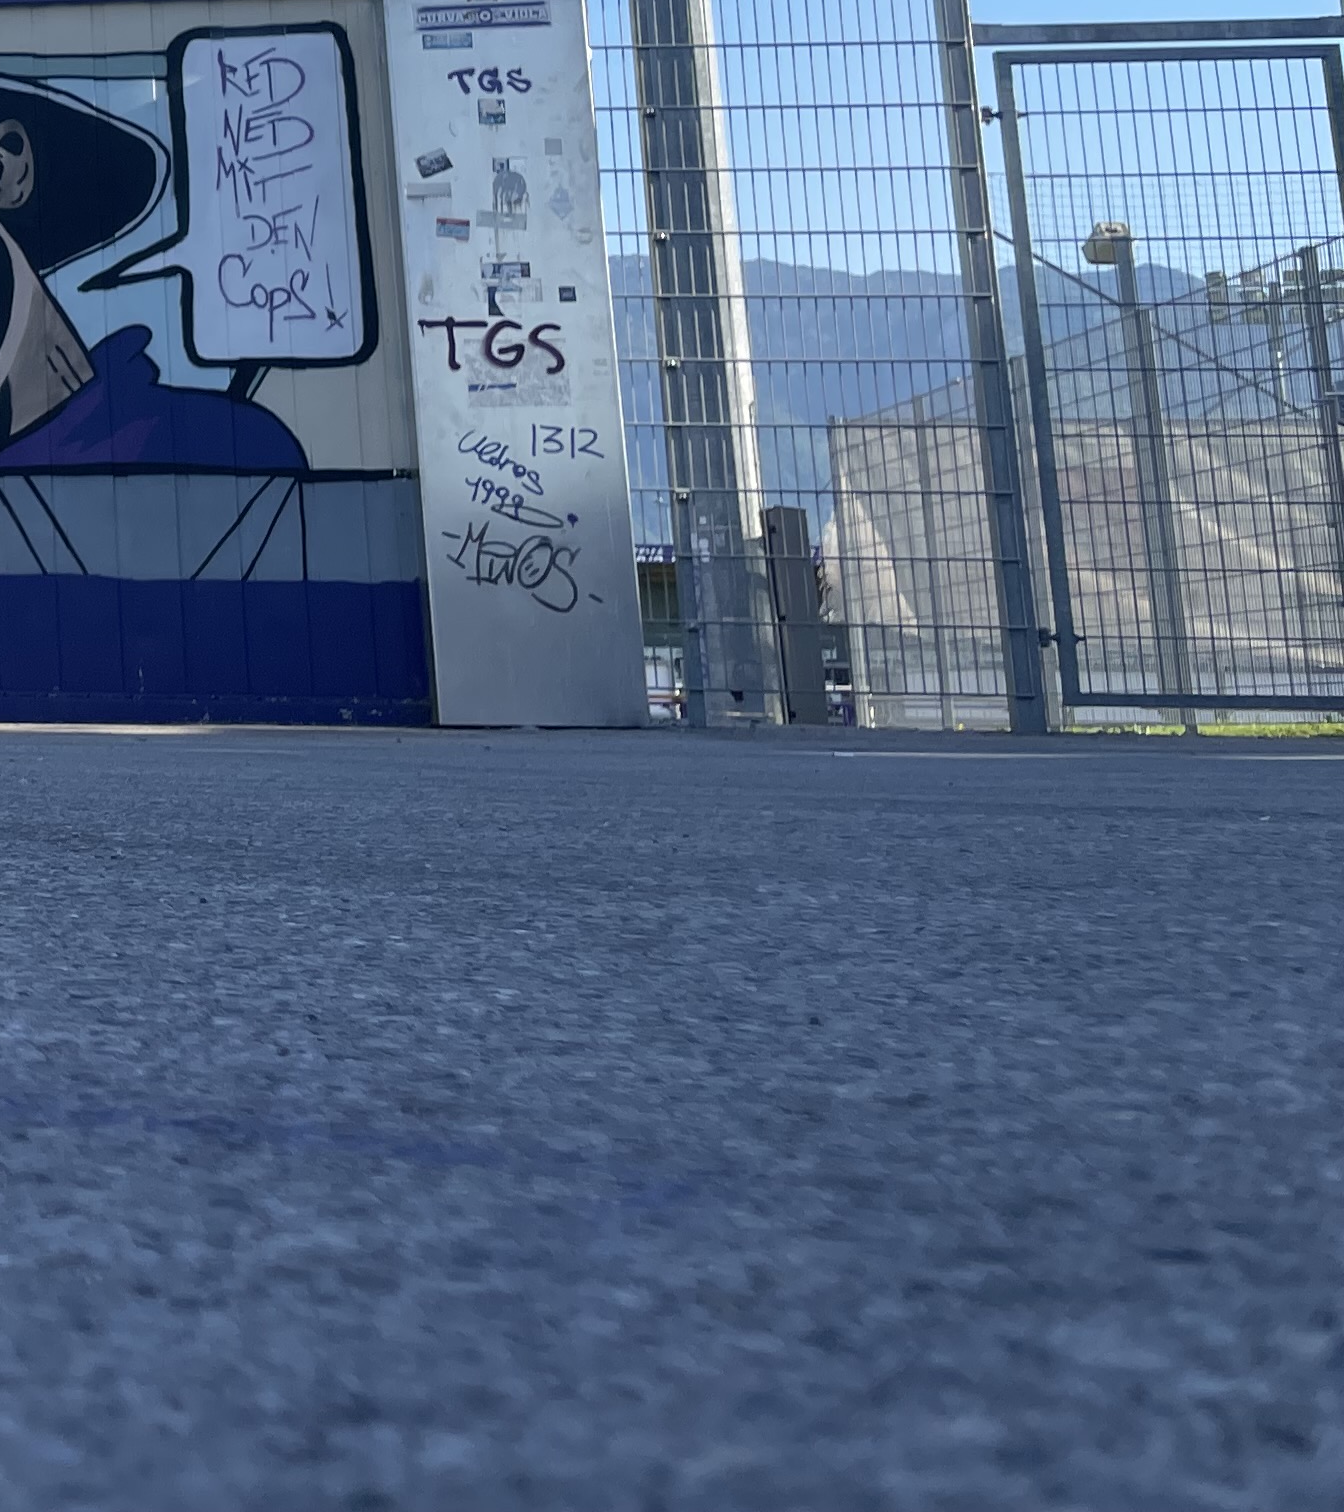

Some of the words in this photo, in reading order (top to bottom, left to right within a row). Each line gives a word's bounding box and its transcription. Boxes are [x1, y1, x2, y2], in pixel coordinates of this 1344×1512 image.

[417, 11, 464, 25] CURVA
[217, 47, 306, 114] RED
[448, 66, 532, 95] TGS
[223, 103, 314, 161] NED
[216, 146, 313, 218] MIT
[242, 194, 319, 261] DEN
[418, 316, 565, 375] TGS
[530, 422, 605, 460] 1312
